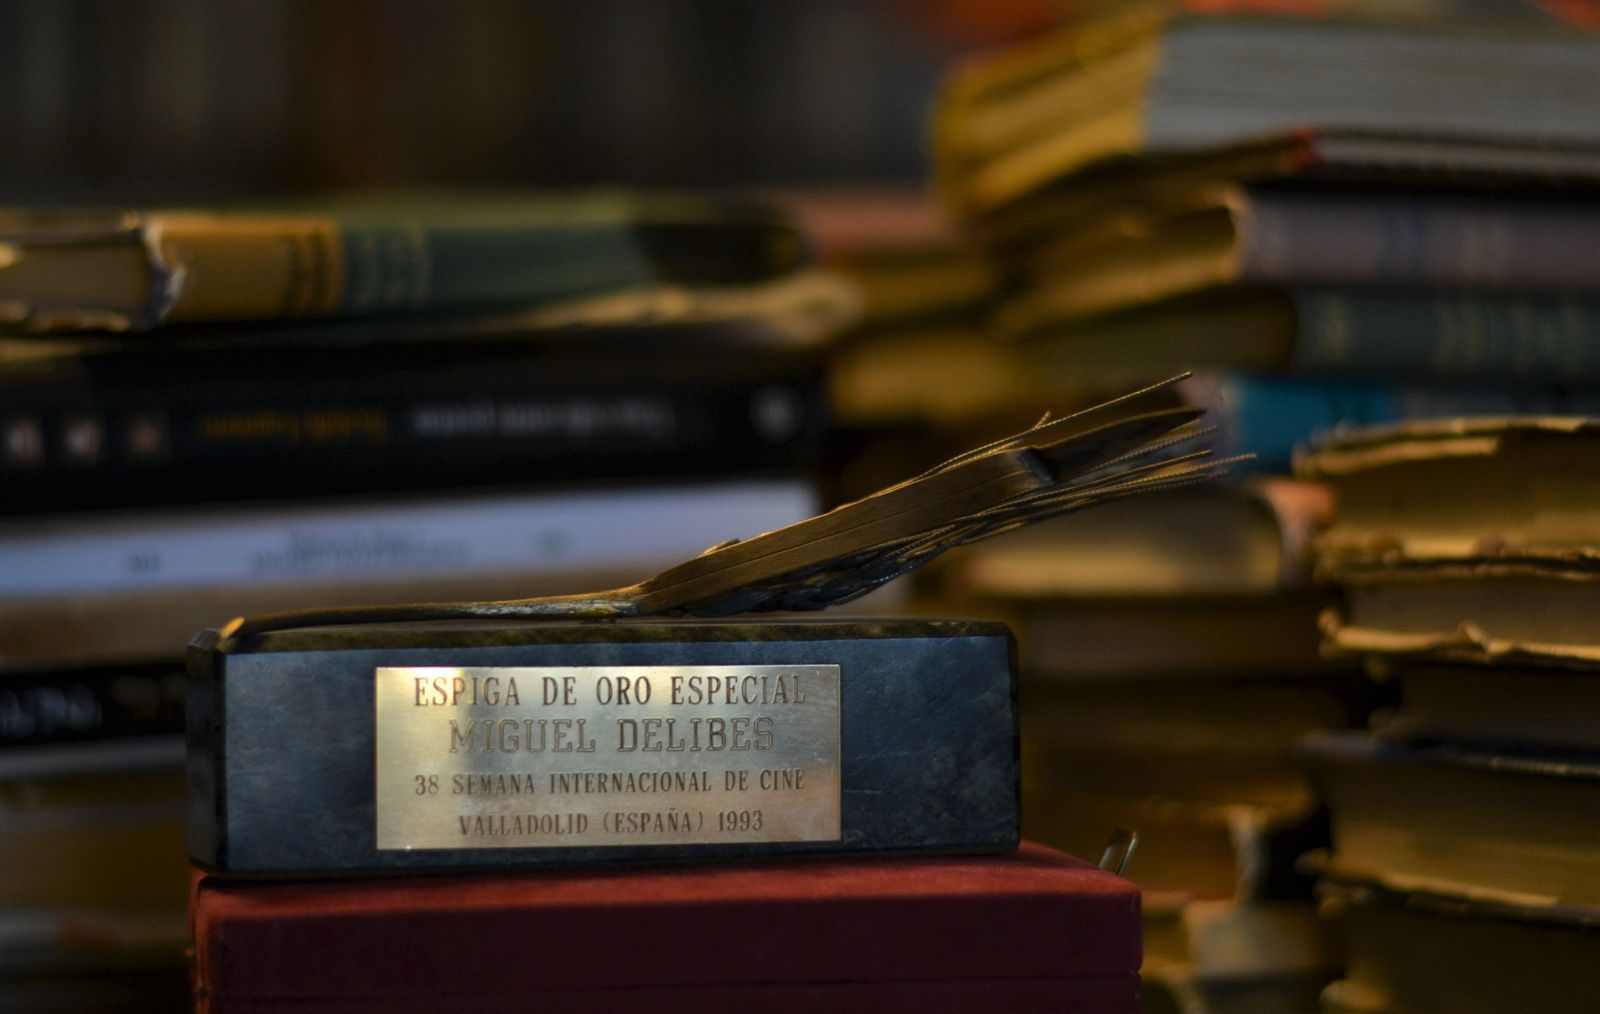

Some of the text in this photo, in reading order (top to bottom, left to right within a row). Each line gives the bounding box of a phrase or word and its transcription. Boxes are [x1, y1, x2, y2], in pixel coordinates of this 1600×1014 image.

[414, 675, 805, 707] ESPIGA DE ORO ESPECIAL
[448, 717, 774, 753] MIGUEL DELIBES
[415, 768, 805, 795] 38 SEMANA INTERNACIONAL DE CINE
[458, 806, 763, 836] VALLADOLID (ESPAÑA) 1993
